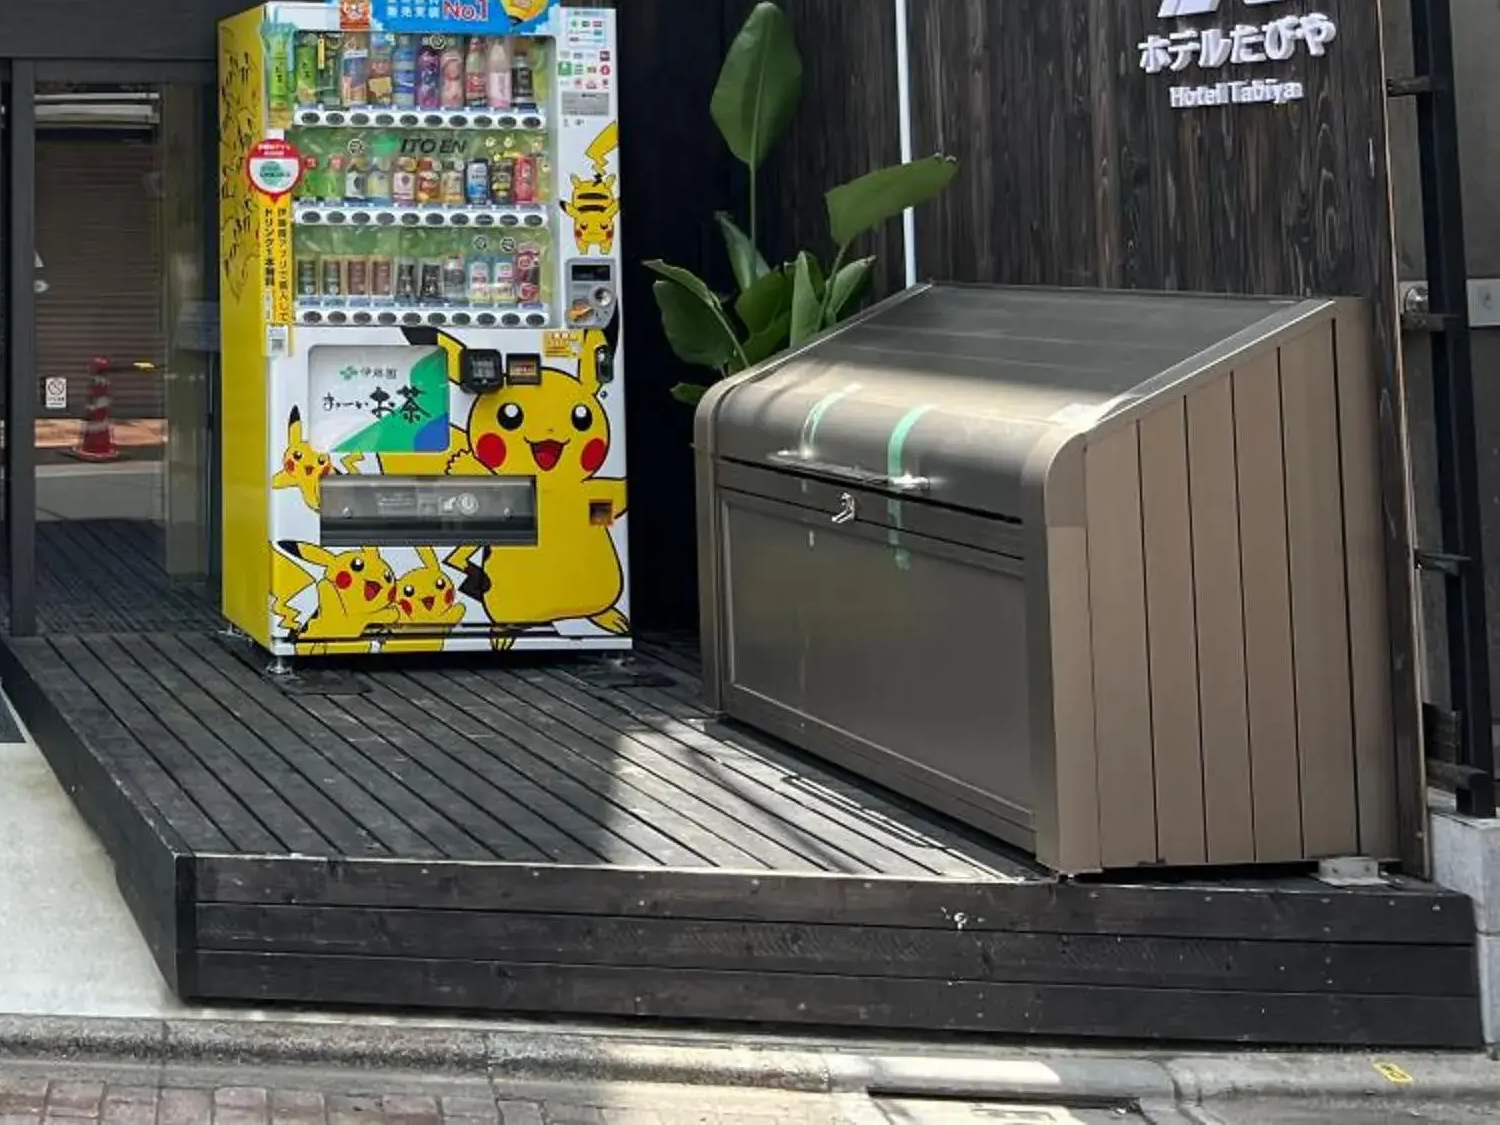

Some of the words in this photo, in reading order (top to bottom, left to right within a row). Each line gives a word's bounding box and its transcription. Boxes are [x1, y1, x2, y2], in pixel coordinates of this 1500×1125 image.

[1137, 12, 1337, 74] ホテルたびや
[1169, 82, 1228, 108] Hotel
[1228, 78, 1304, 105] Tabiya
[400, 138, 437, 154] ITO
[440, 138, 467, 154] EN
